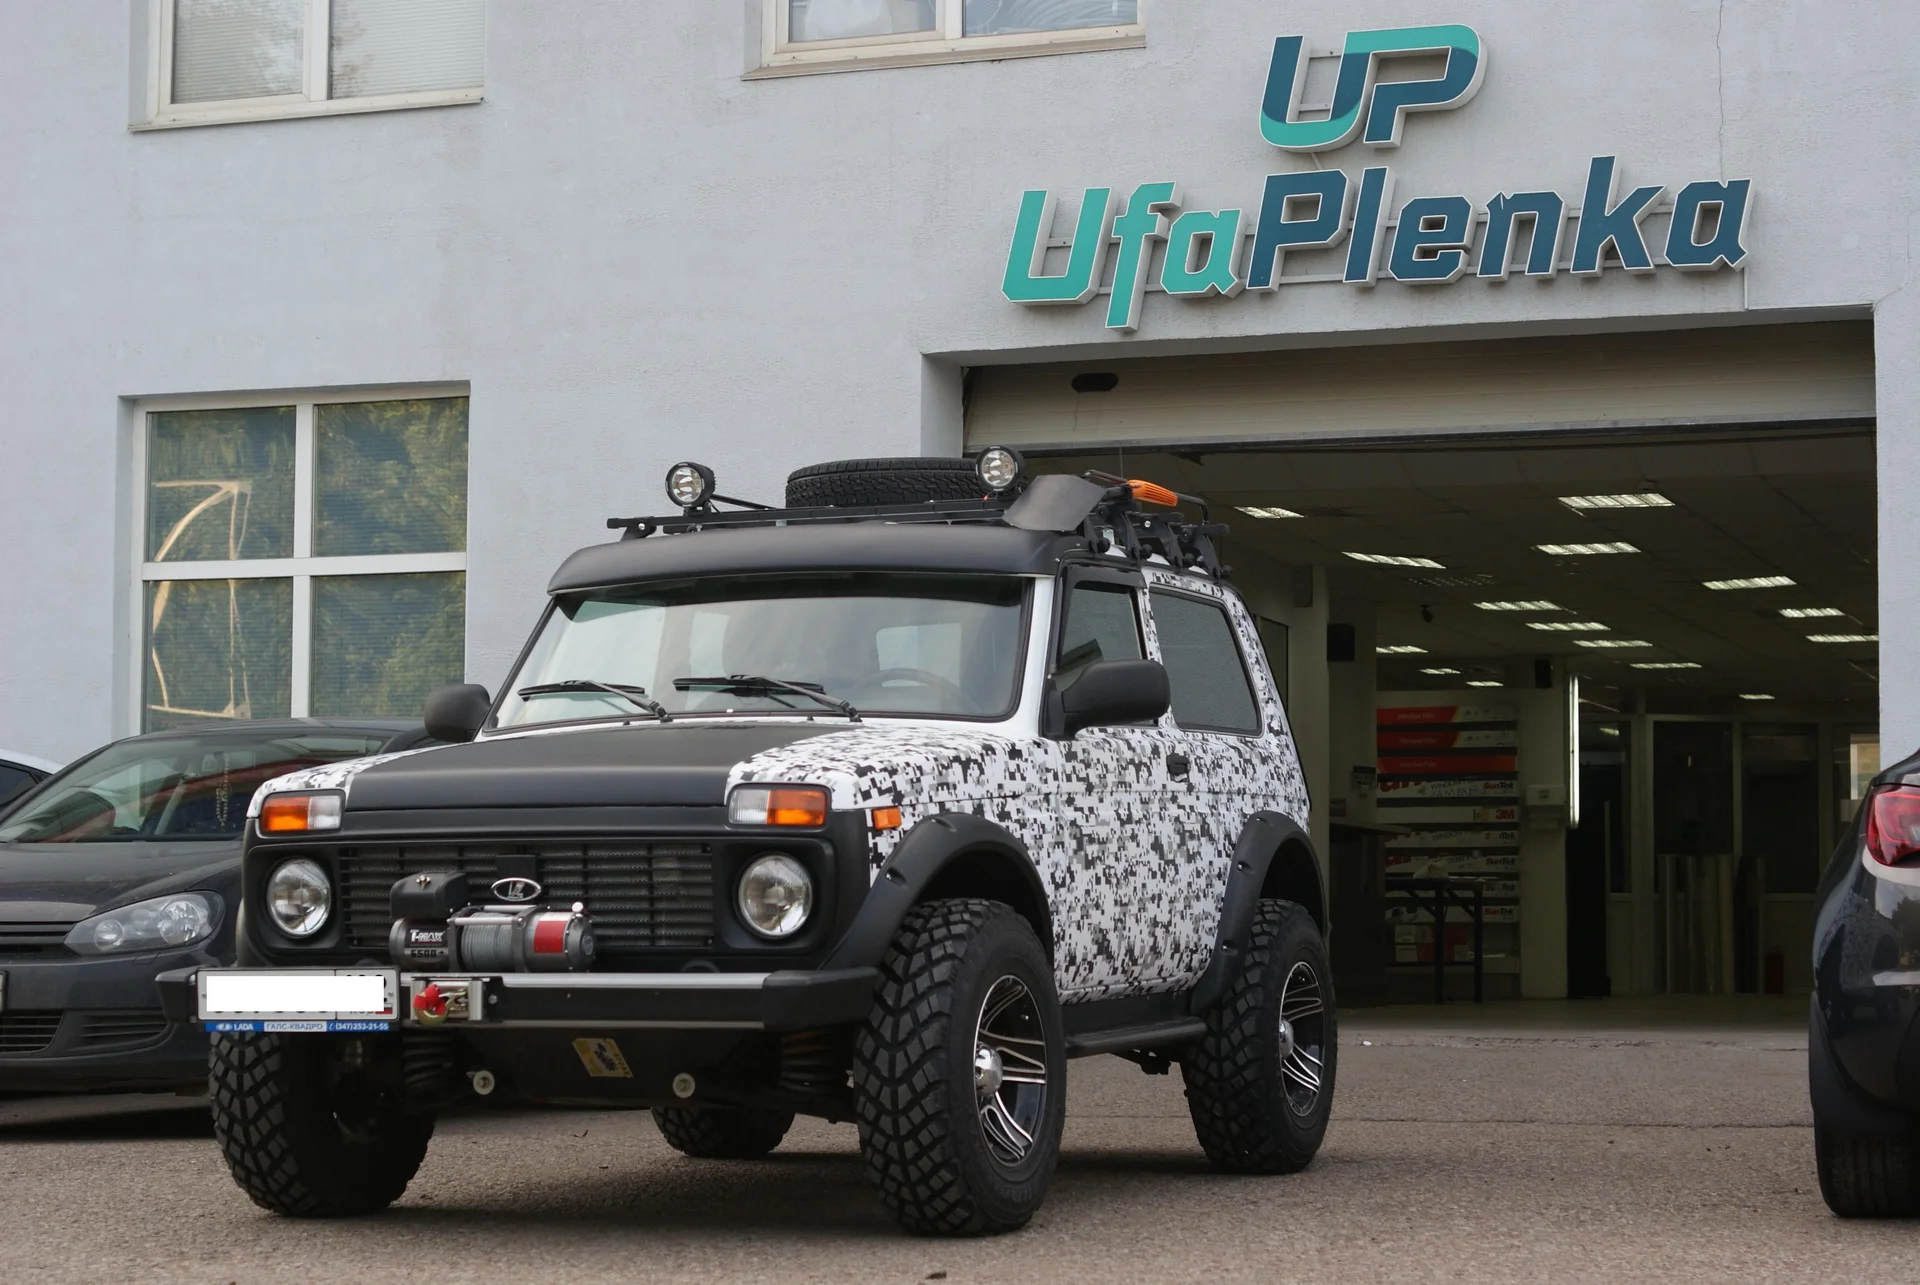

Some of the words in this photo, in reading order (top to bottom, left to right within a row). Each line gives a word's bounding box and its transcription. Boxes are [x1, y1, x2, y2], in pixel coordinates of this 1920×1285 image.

[1001, 155, 1753, 331] UfaPlenka
[1483, 781, 1514, 789] SunTek
[1495, 809, 1515, 820] 3M
[1485, 857, 1515, 866] SunTek
[1484, 907, 1513, 915] SunTek
[409, 929, 446, 942] T-MAX
[233, 1023, 254, 1031] LADA
[266, 1023, 323, 1031] ГАЛС-КВАДРО
